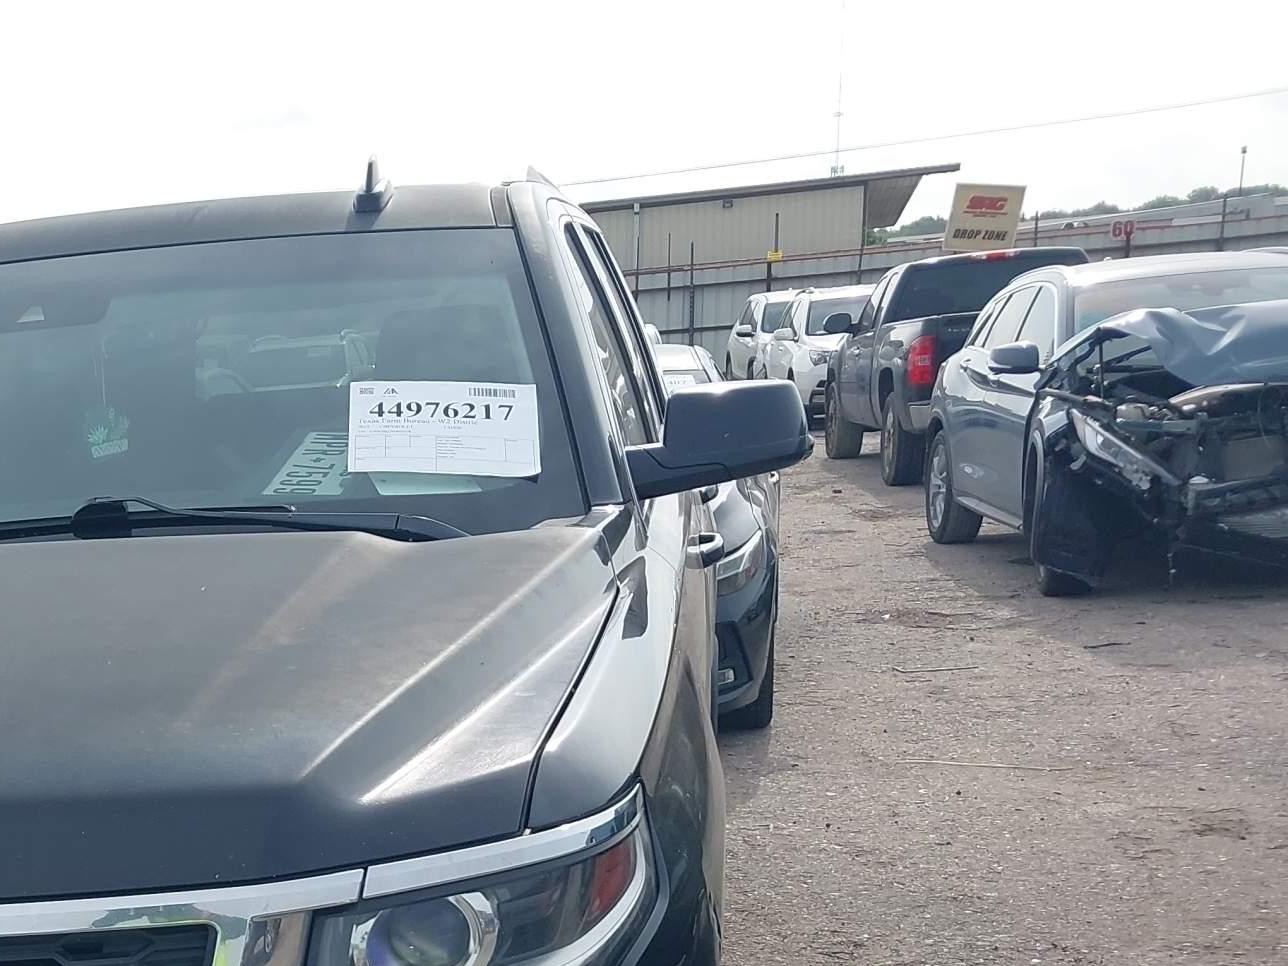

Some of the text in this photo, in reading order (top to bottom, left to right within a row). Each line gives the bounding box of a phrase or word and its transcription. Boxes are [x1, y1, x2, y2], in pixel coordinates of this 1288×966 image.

[953, 228, 1009, 241] DROP ZONE
[1112, 220, 1135, 237] 60
[369, 401, 515, 421] 44976217
[272, 463, 336, 494] 7599
